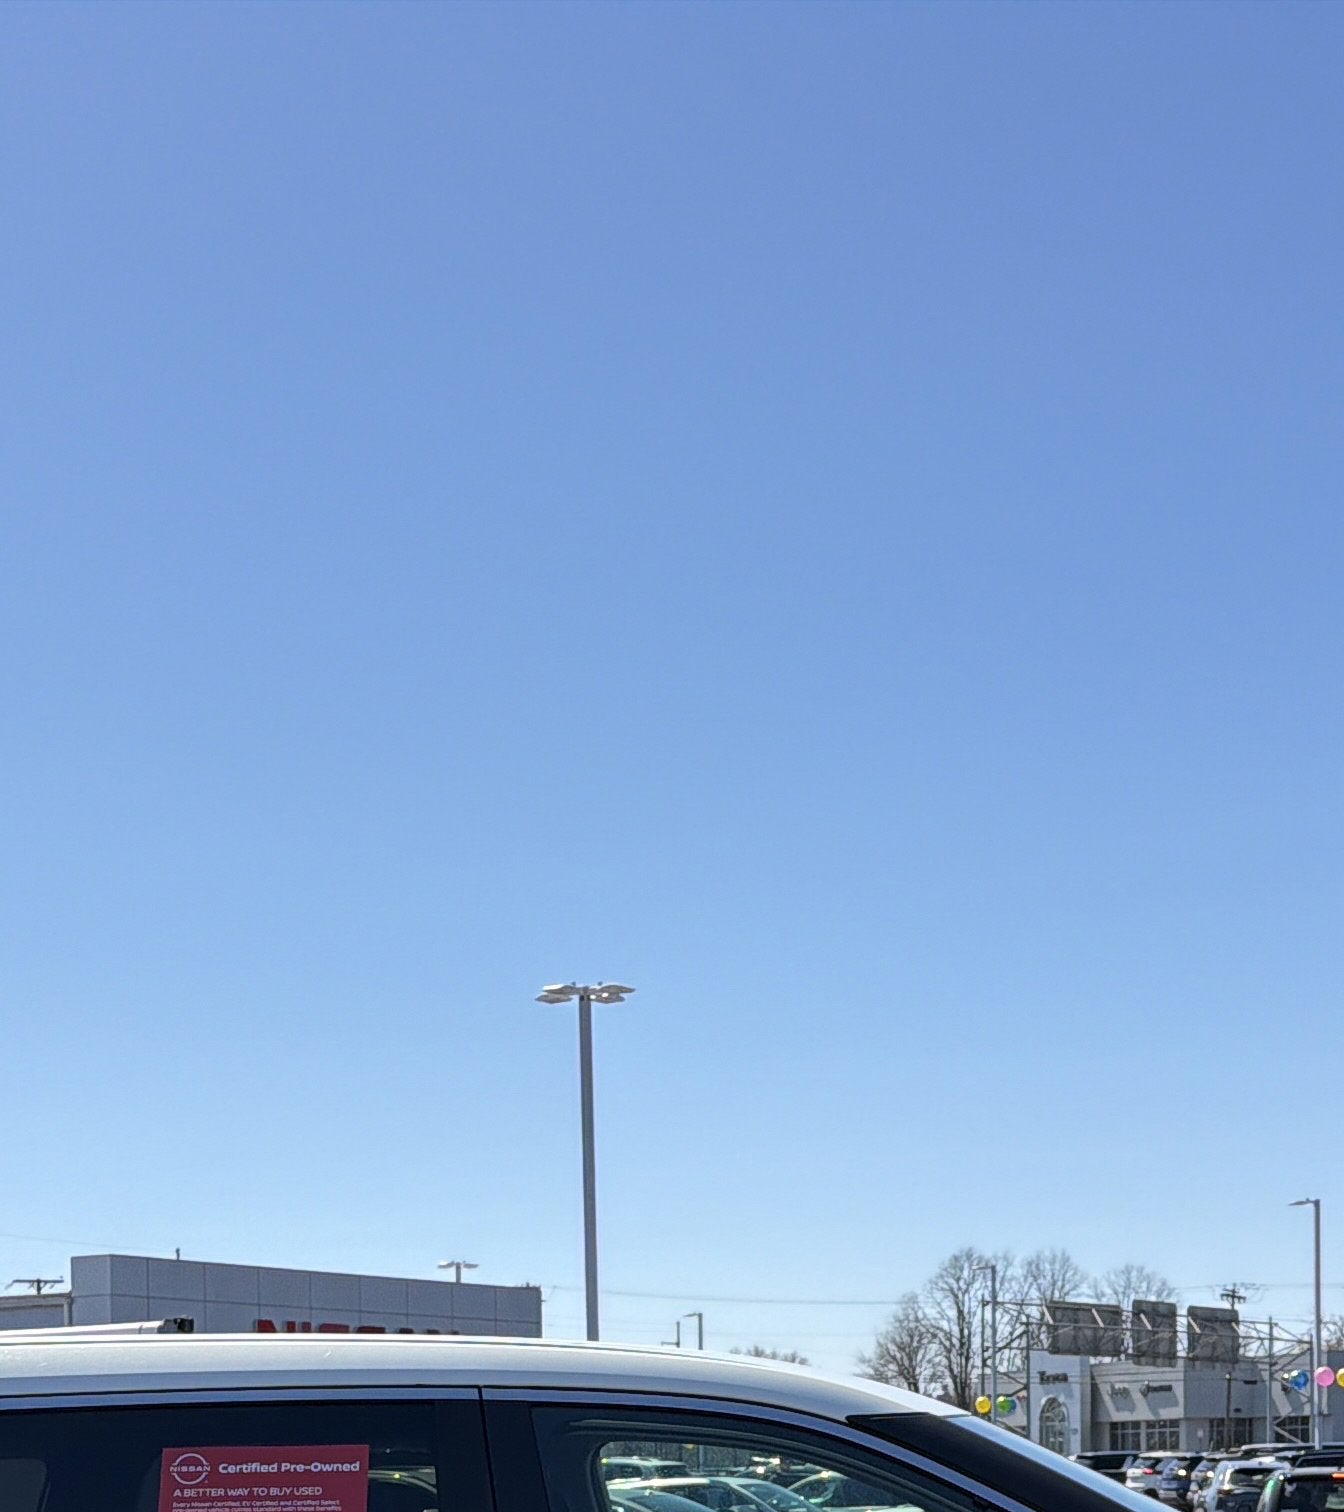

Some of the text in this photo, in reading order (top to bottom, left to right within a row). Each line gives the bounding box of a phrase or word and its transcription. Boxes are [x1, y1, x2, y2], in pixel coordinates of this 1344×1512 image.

[219, 1461, 360, 1474] Certified Pre-Owned
[173, 1486, 323, 1498] A BETTER WAY TO BUY USED
